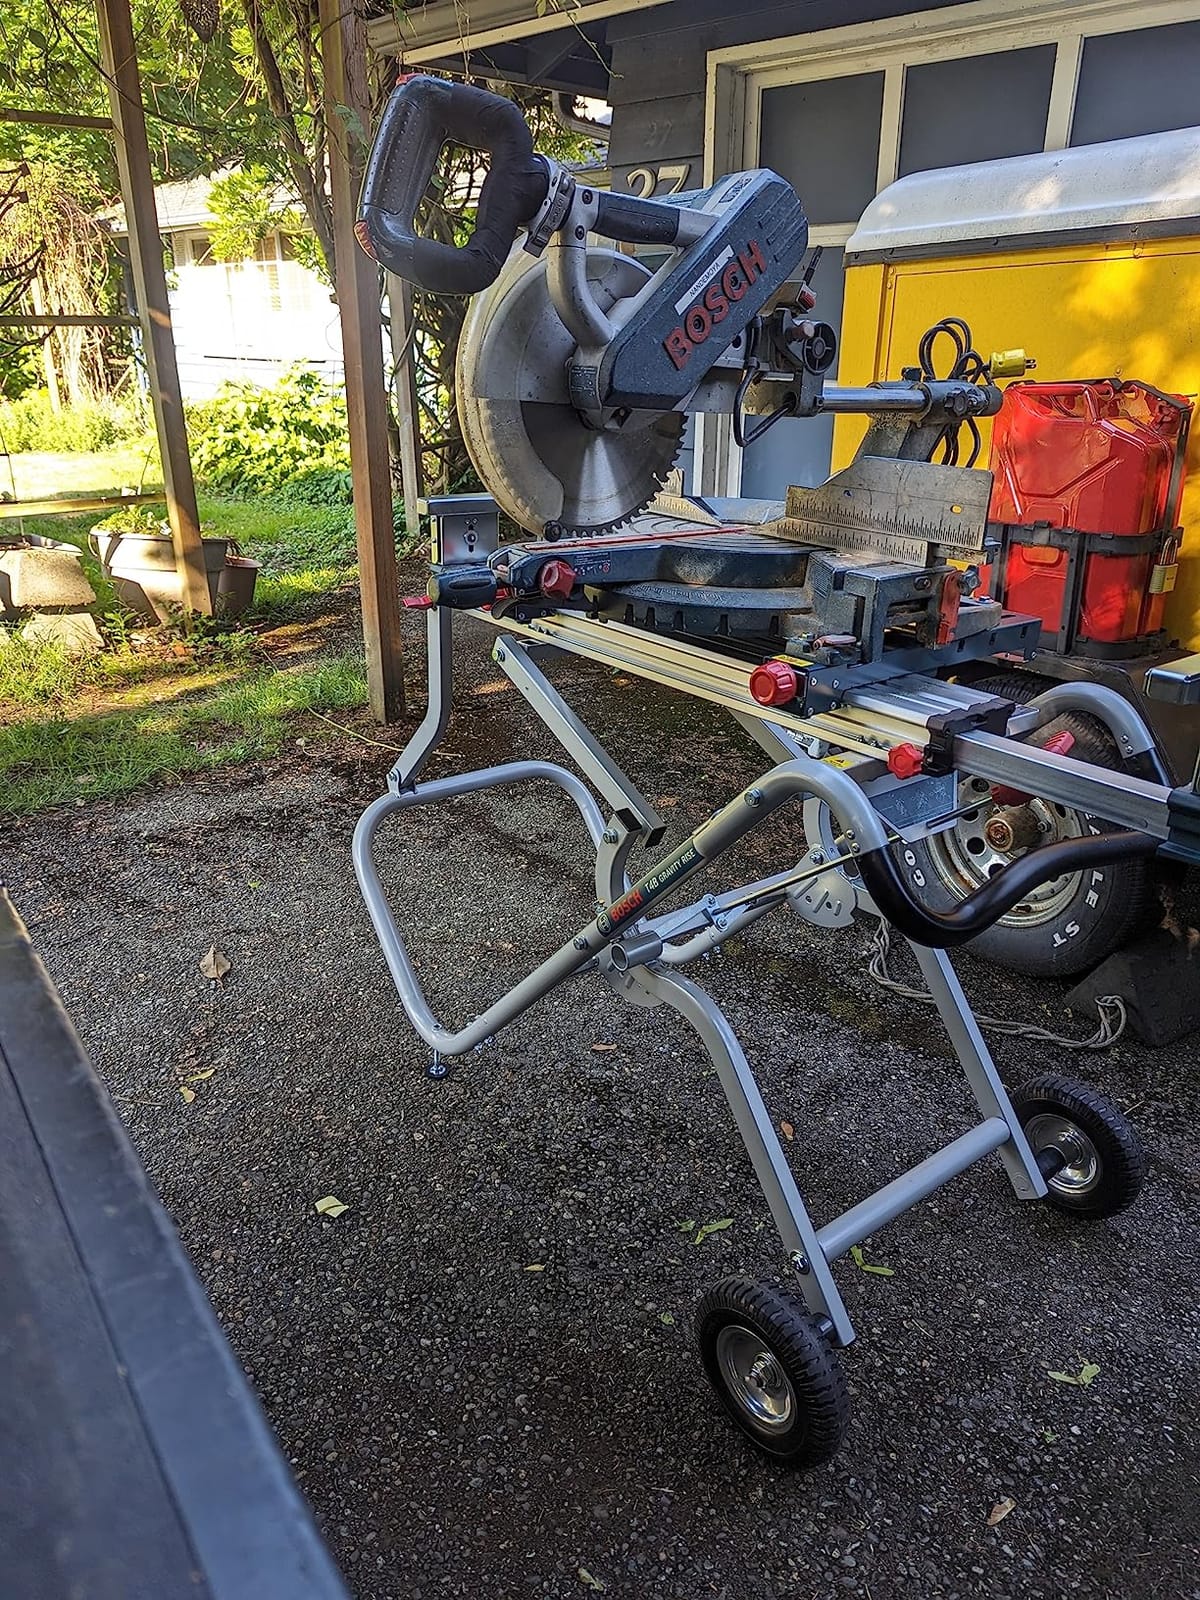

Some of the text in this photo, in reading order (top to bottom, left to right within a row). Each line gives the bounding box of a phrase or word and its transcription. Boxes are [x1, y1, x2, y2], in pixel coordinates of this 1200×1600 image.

[626, 164, 690, 199] 27
[663, 239, 768, 370] BOSCH
[610, 848, 695, 922] BOSCH T4B GRAVITY RISE
[1053, 920, 1080, 948] ST
